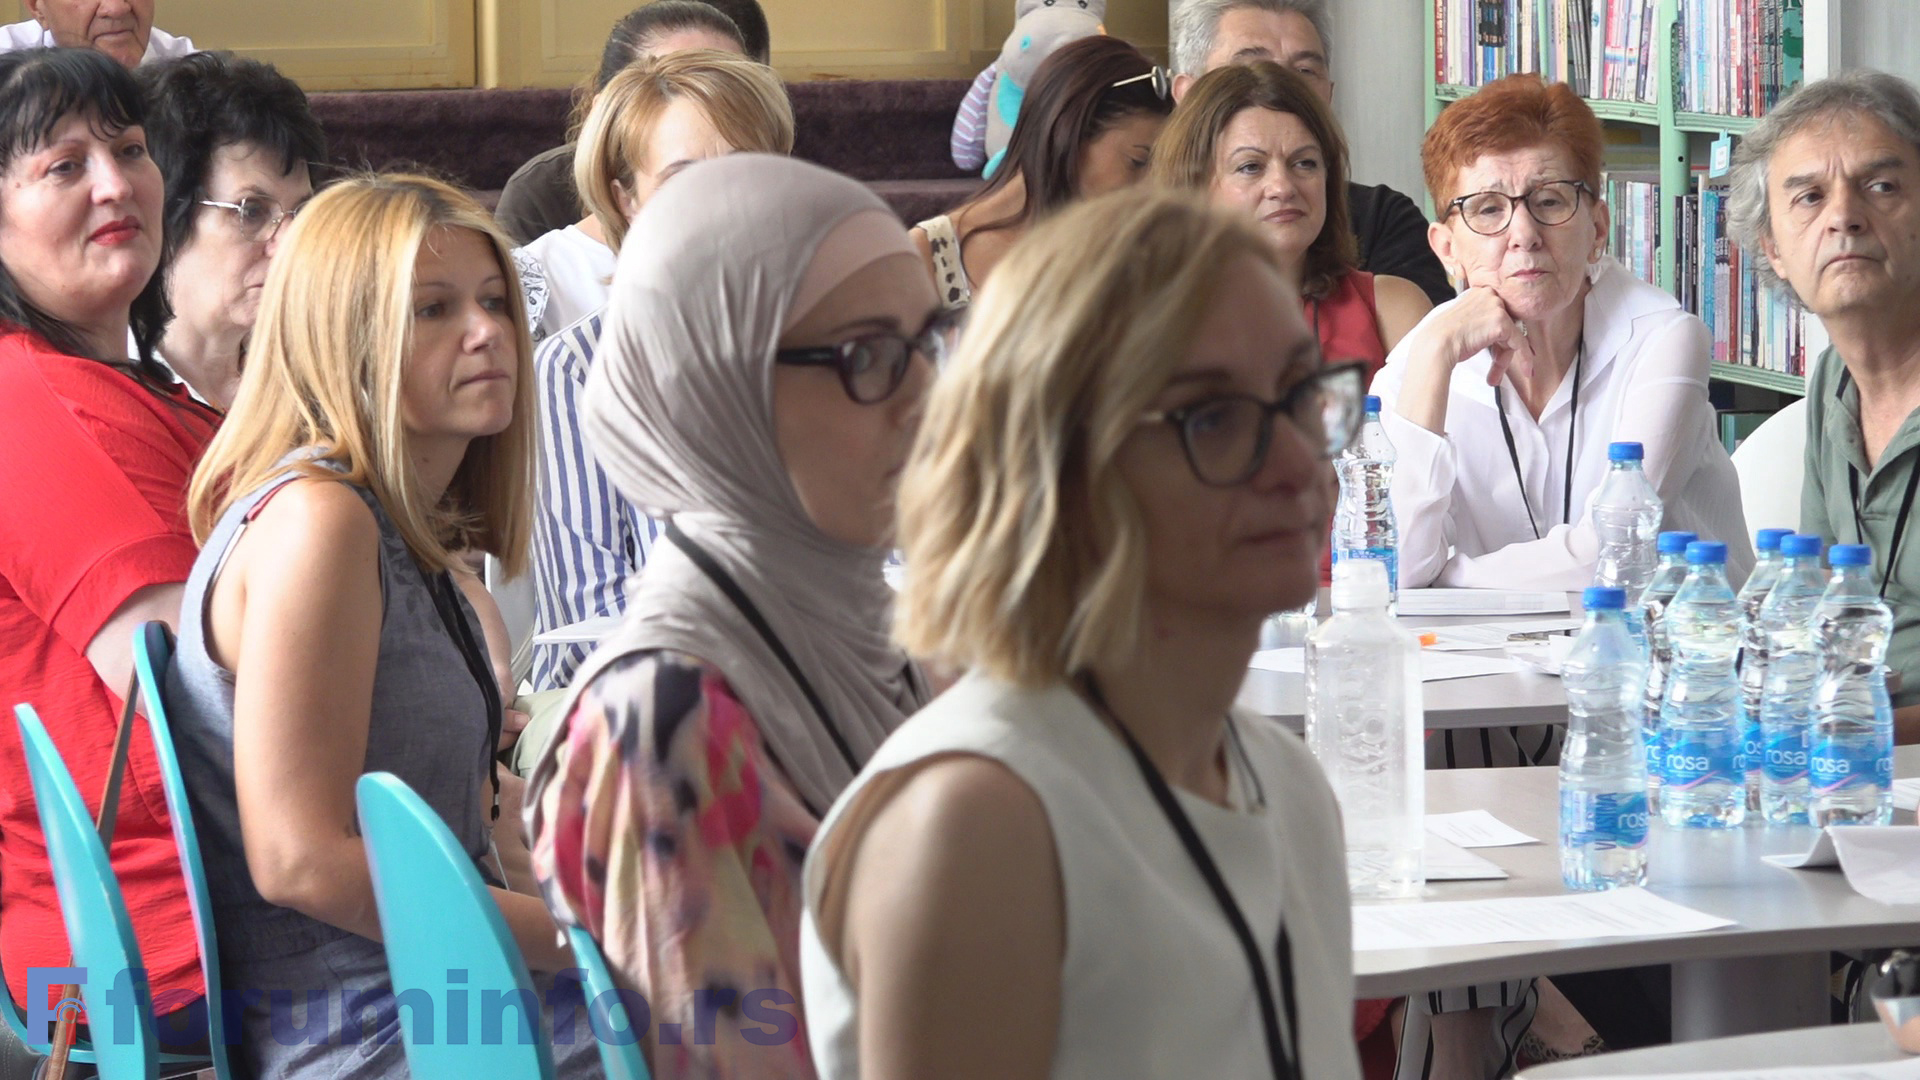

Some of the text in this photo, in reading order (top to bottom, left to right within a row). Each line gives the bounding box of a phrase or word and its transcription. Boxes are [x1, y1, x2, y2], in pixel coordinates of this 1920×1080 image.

[1667, 754, 1710, 771] rosa
[1765, 749, 1807, 766] rosa
[1811, 756, 1850, 774] rosa
